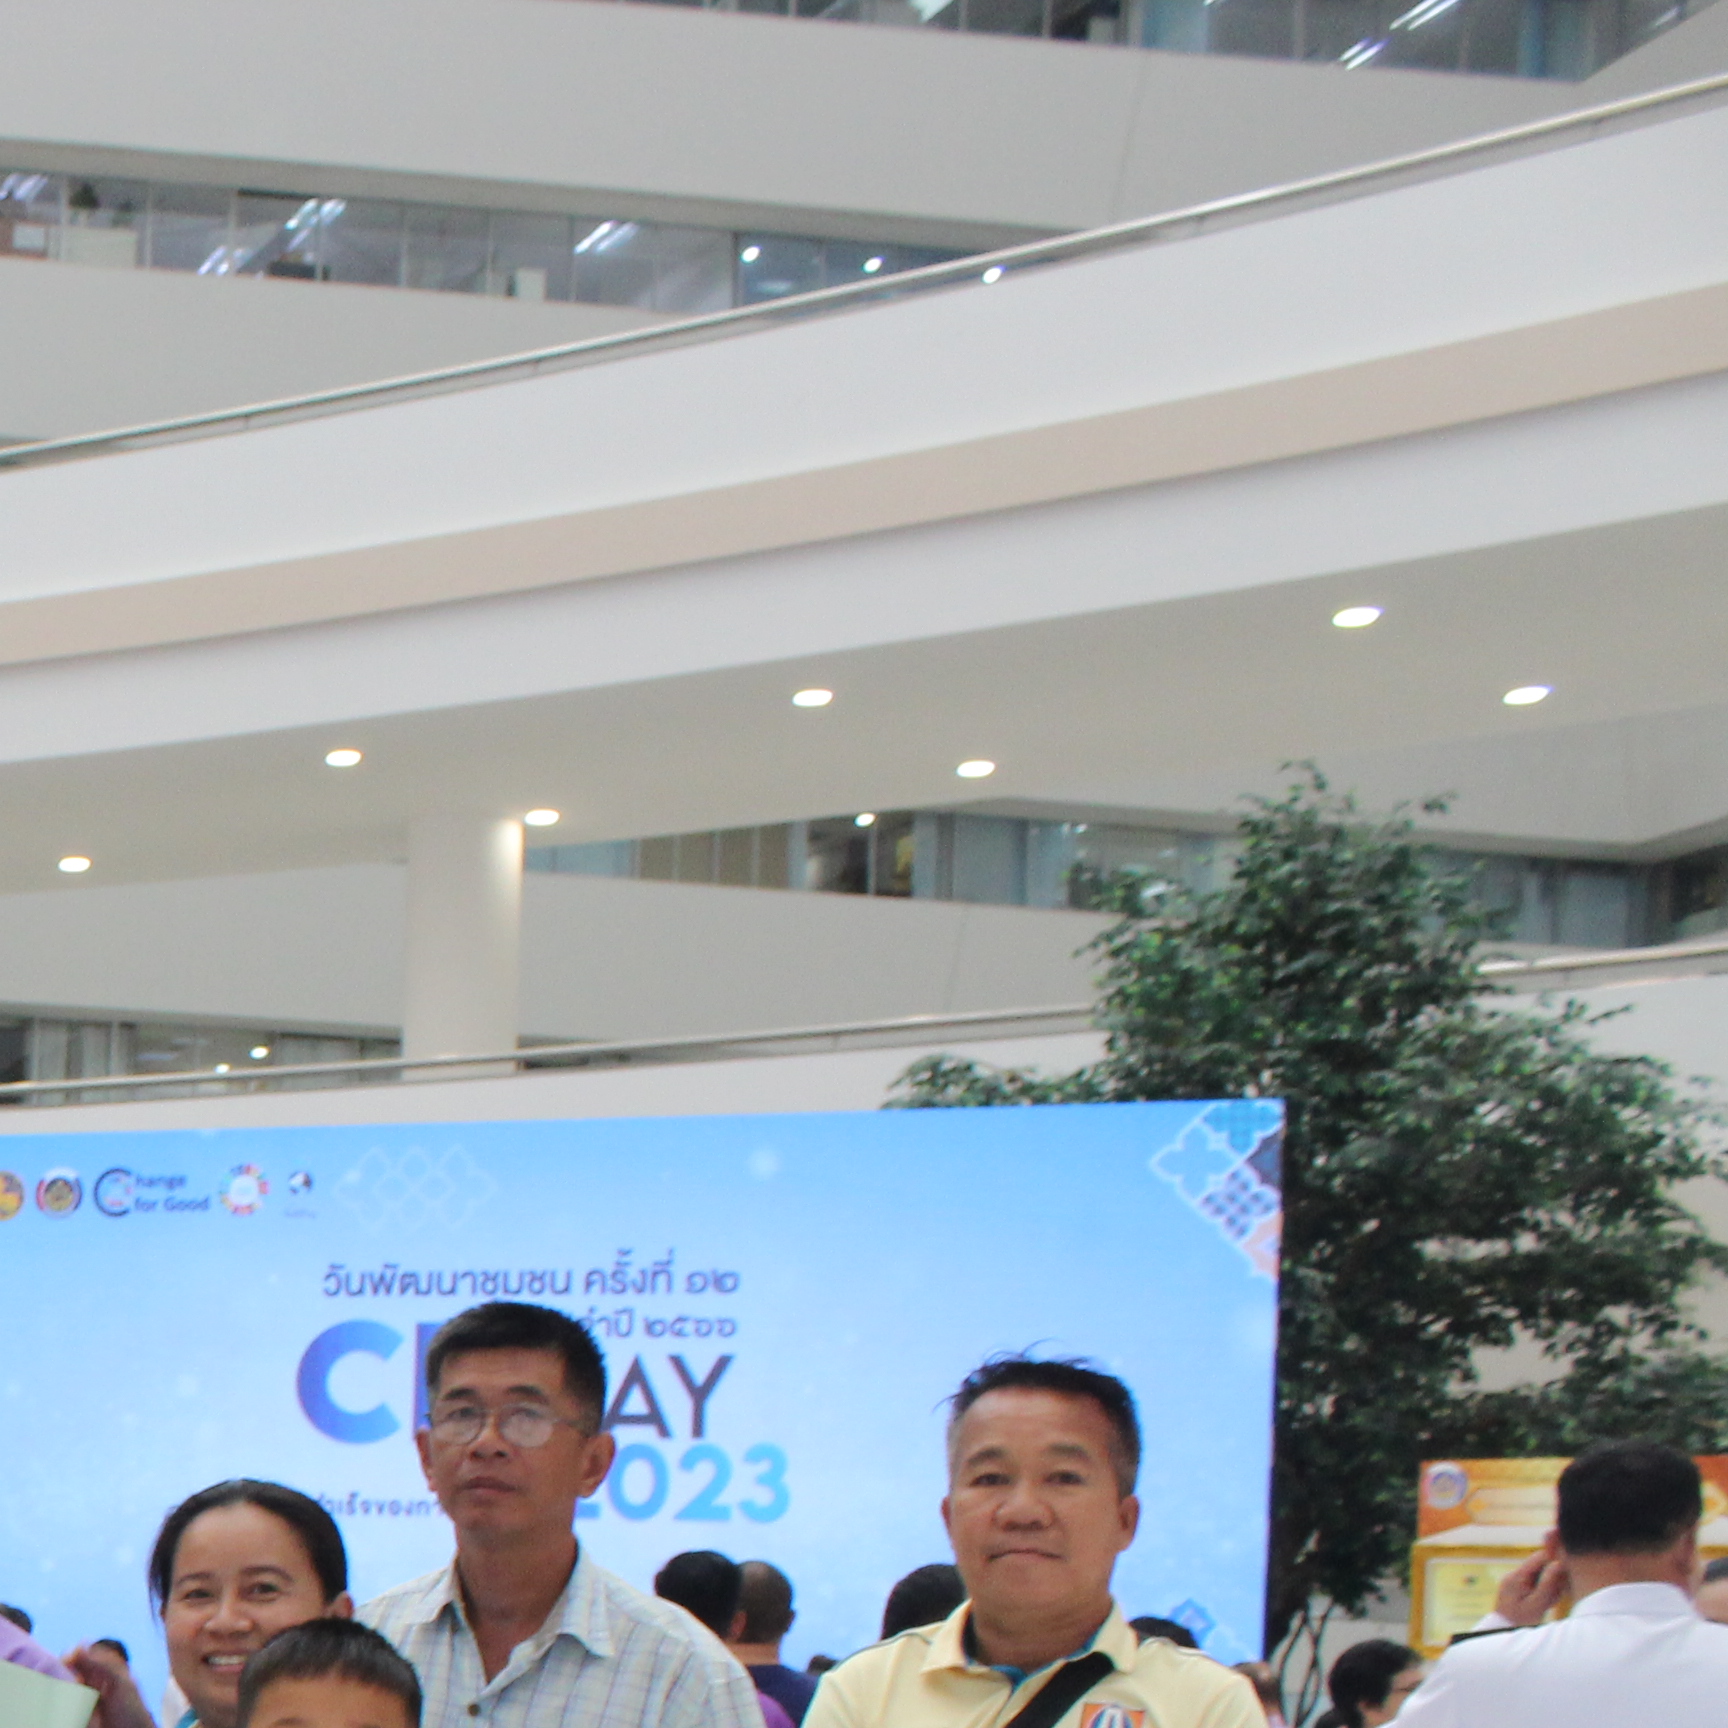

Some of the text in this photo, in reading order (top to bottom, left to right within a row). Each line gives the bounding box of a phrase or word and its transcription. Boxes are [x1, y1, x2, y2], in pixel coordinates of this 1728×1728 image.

[322, 1247, 741, 1301] วันพัฒนาชมชน ครั้งที่ ๑๒
[602, 1353, 736, 1440] AY
